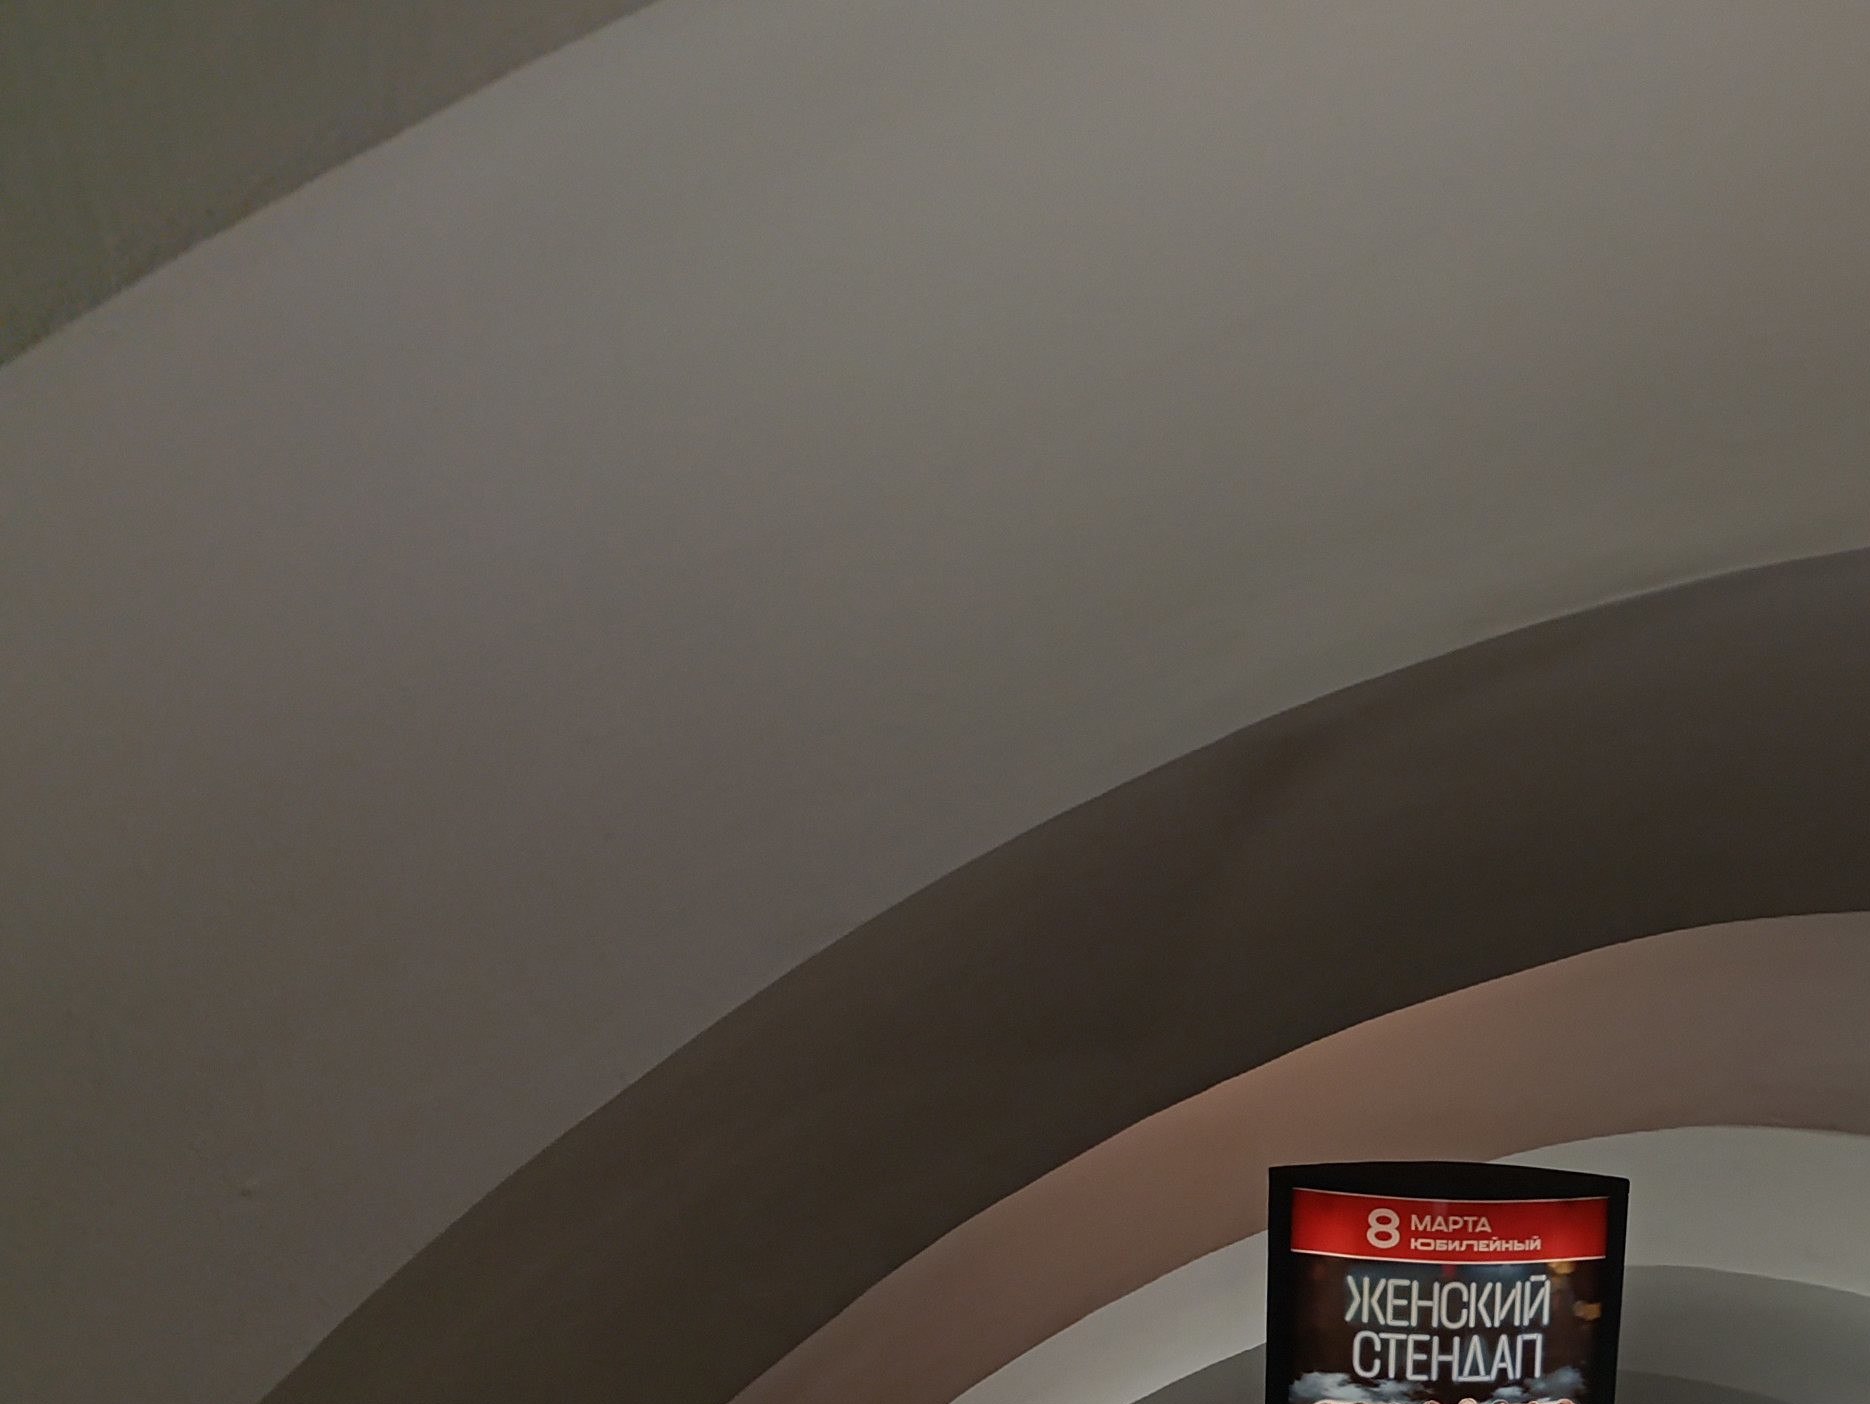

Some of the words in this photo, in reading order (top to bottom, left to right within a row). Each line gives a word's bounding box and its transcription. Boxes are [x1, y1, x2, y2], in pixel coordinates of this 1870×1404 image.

[1366, 1207, 1400, 1249] 8
[1410, 1214, 1492, 1233] МАРТА
[1410, 1235, 1542, 1252] ЮБИЛЕЙНЫЙ
[1344, 1274, 1551, 1329] ЖЕНСКИЙ
[1352, 1330, 1543, 1382] СТЕНДАП
